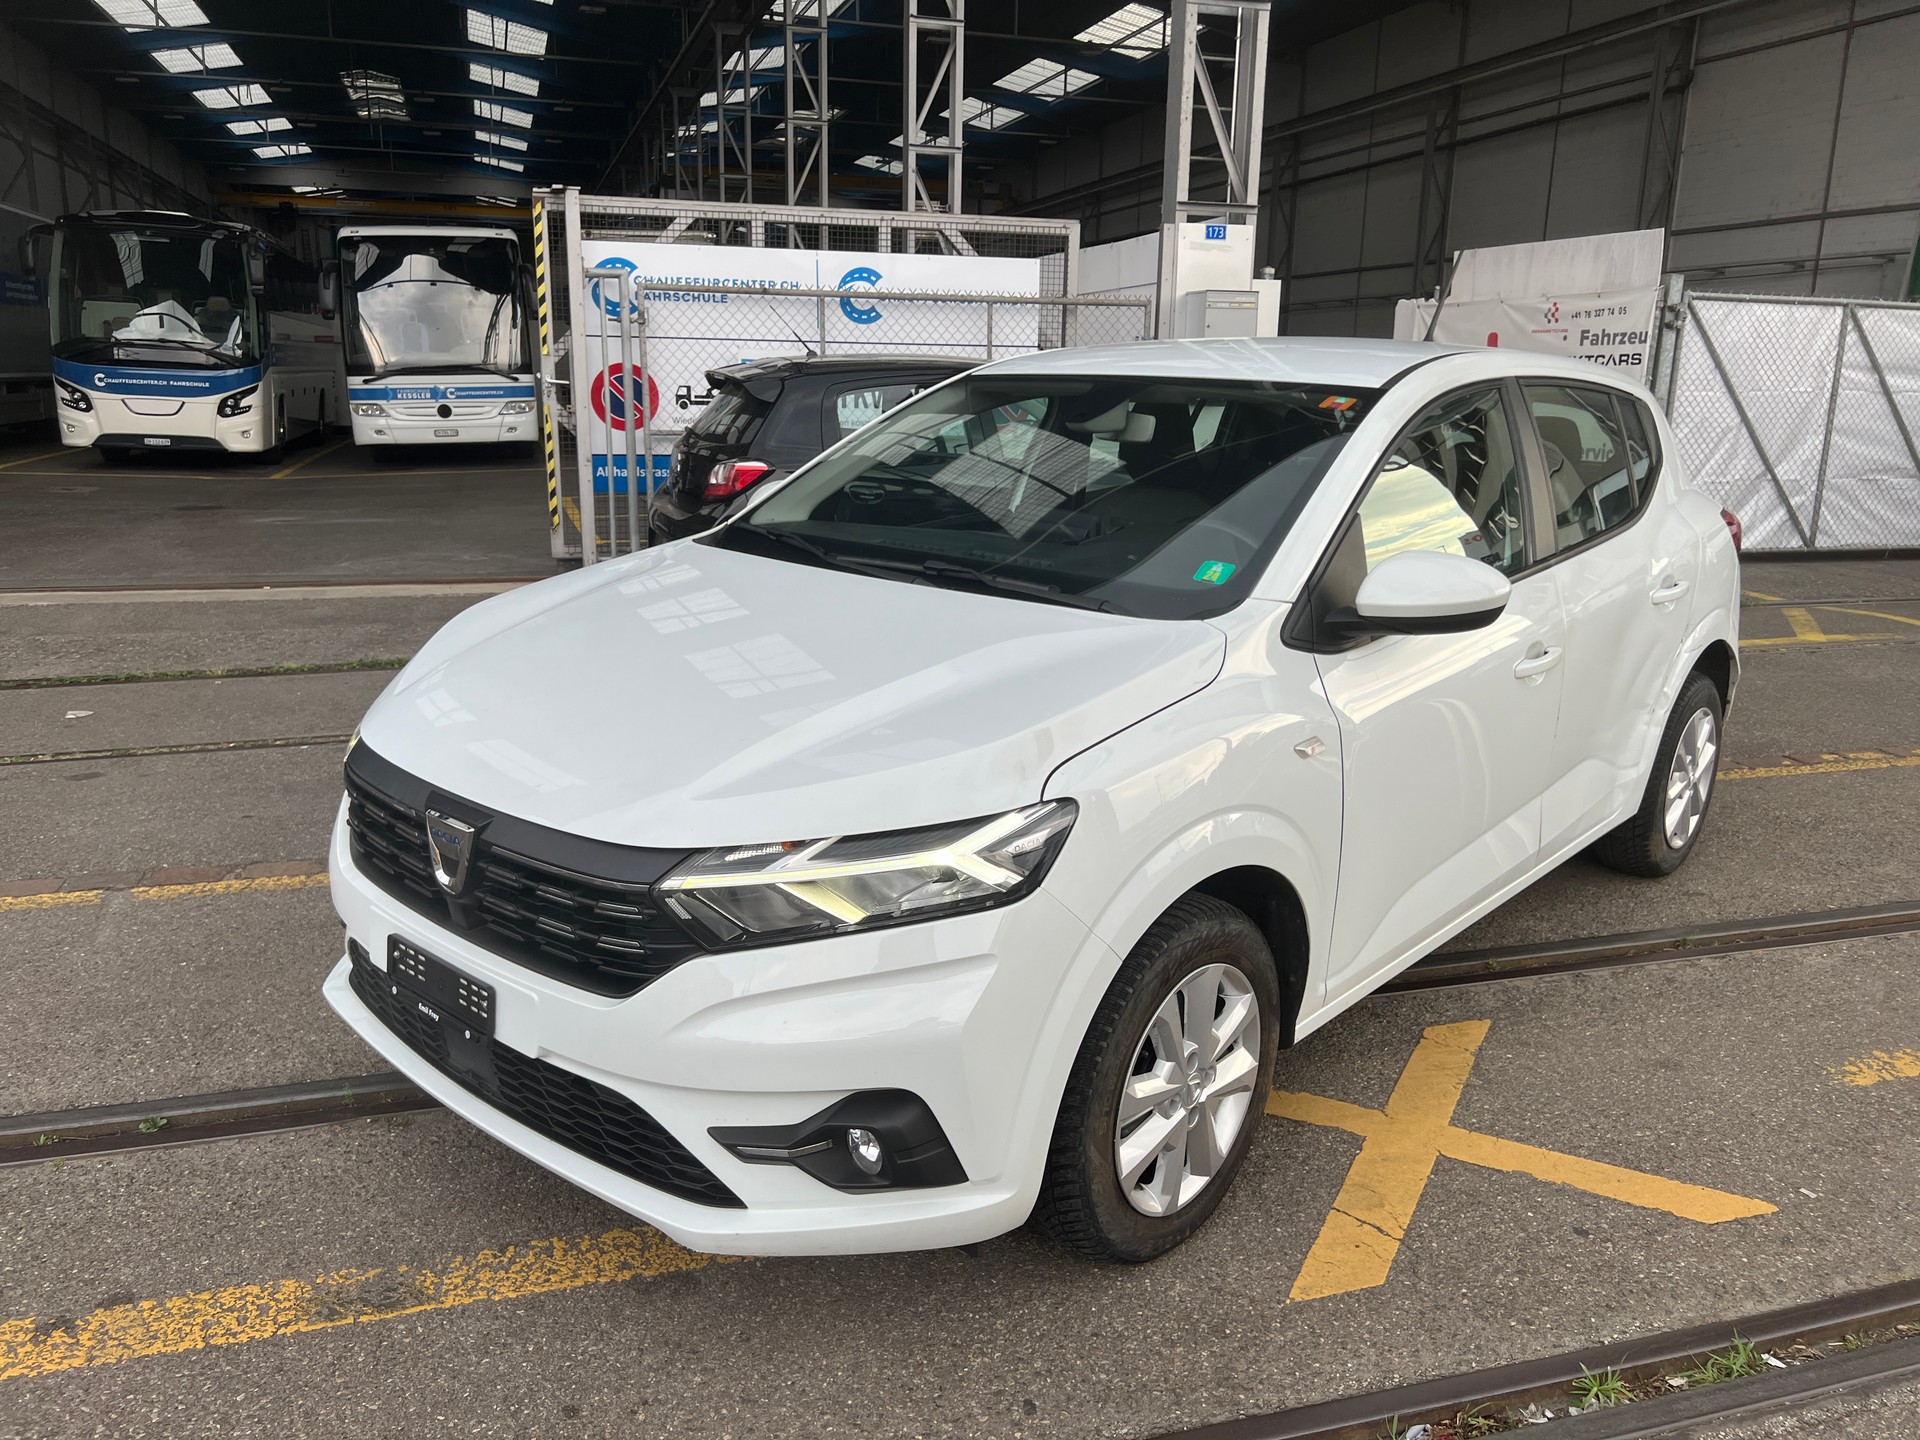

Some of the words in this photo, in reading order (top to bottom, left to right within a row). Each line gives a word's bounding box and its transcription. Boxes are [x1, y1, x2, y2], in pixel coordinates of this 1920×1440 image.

[1208, 227, 1224, 238] 173
[633, 275, 799, 289] CHAUFFEURCENTERCH
[1594, 308, 1606, 317] 327
[1607, 307, 1615, 316] 74
[1618, 306, 1627, 315] 05
[1579, 329, 1649, 346] Fahrzeu
[430, 827, 461, 846] DACIA
[1014, 838, 1041, 852] DACIA
